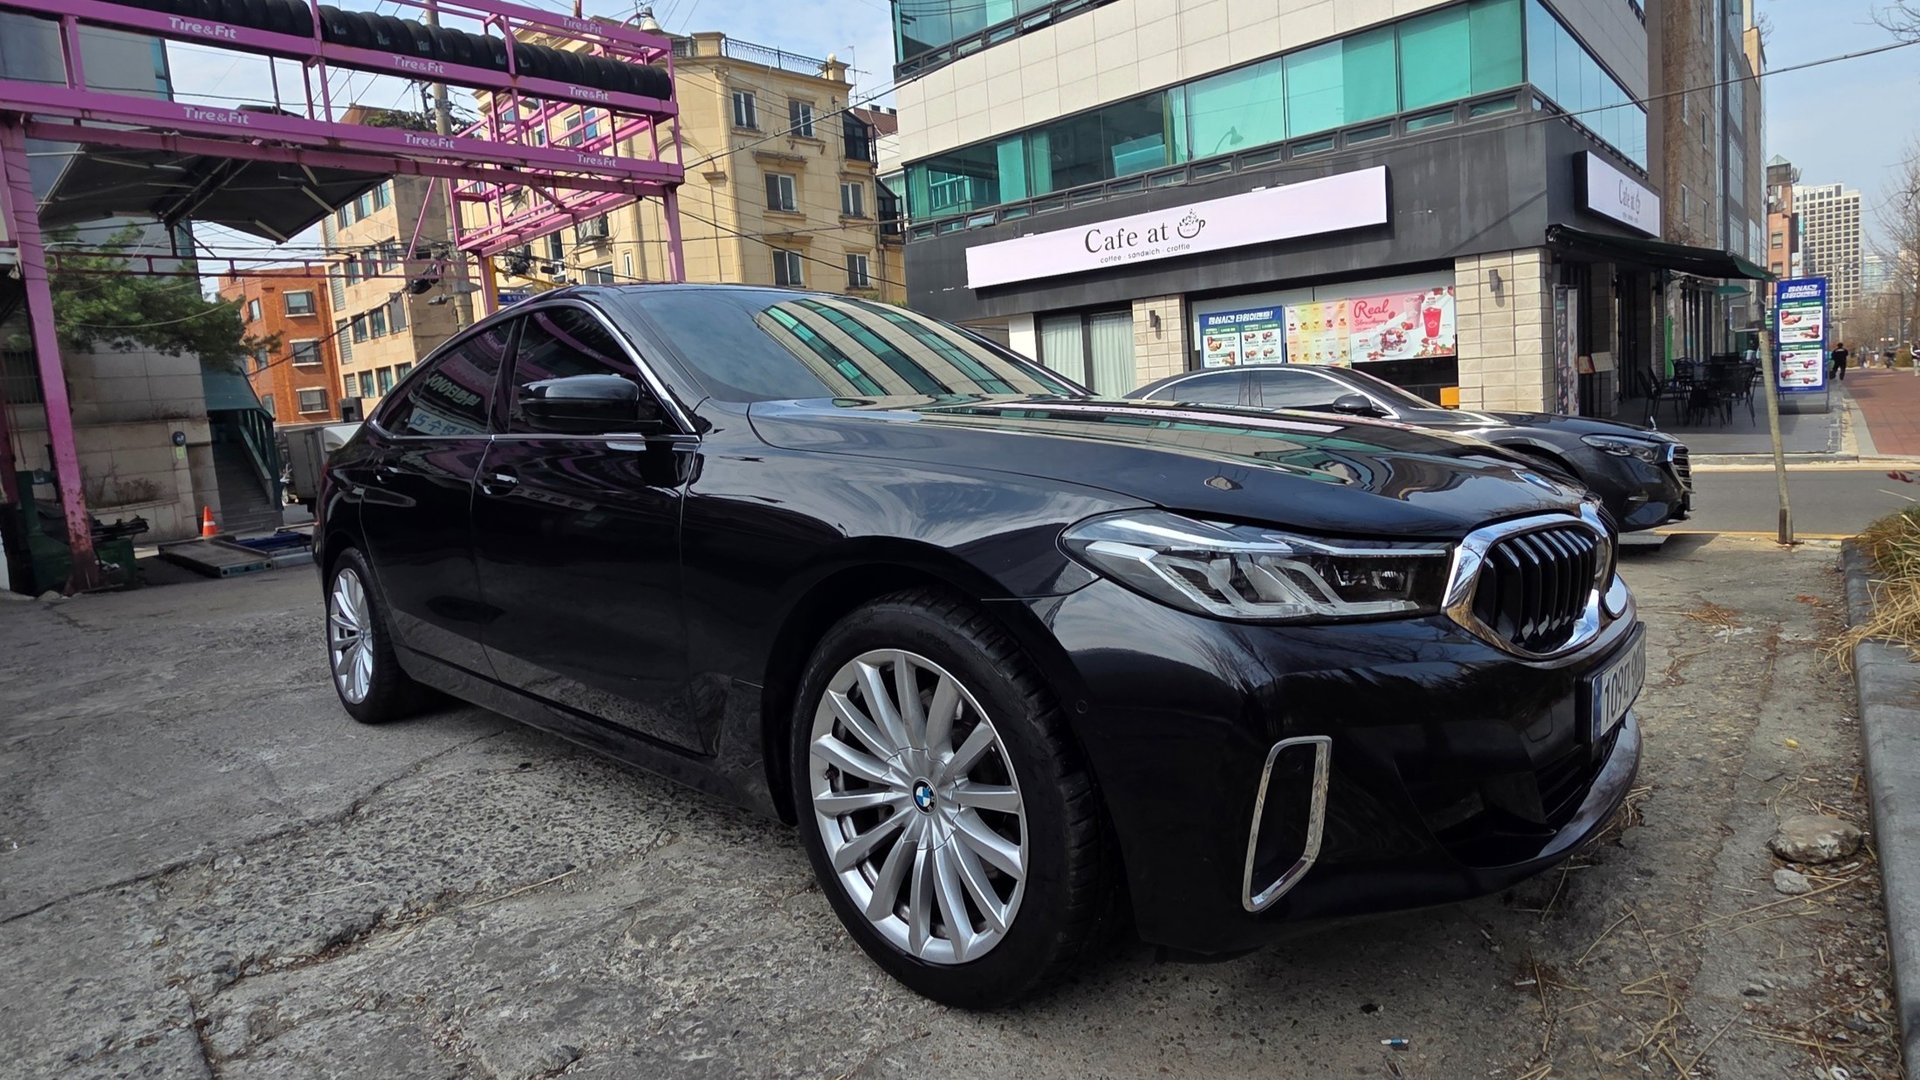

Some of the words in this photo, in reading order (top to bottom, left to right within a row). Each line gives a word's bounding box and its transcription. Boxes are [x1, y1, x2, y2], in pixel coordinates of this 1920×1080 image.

[168, 16, 237, 40] Tire&Fit
[562, 17, 602, 34] Tire&Fit
[392, 54, 444, 74] Tire&Fit
[568, 86, 609, 101] Tire&Fit
[184, 106, 249, 126] Tire&Fit
[404, 133, 455, 150] Tire&Fit
[577, 153, 617, 168] Tire&Fit
[1084, 228, 1138, 253] Cafe
[1147, 222, 1169, 243] at
[1128, 248, 1160, 260] sandwich
[1354, 298, 1389, 319] Real
